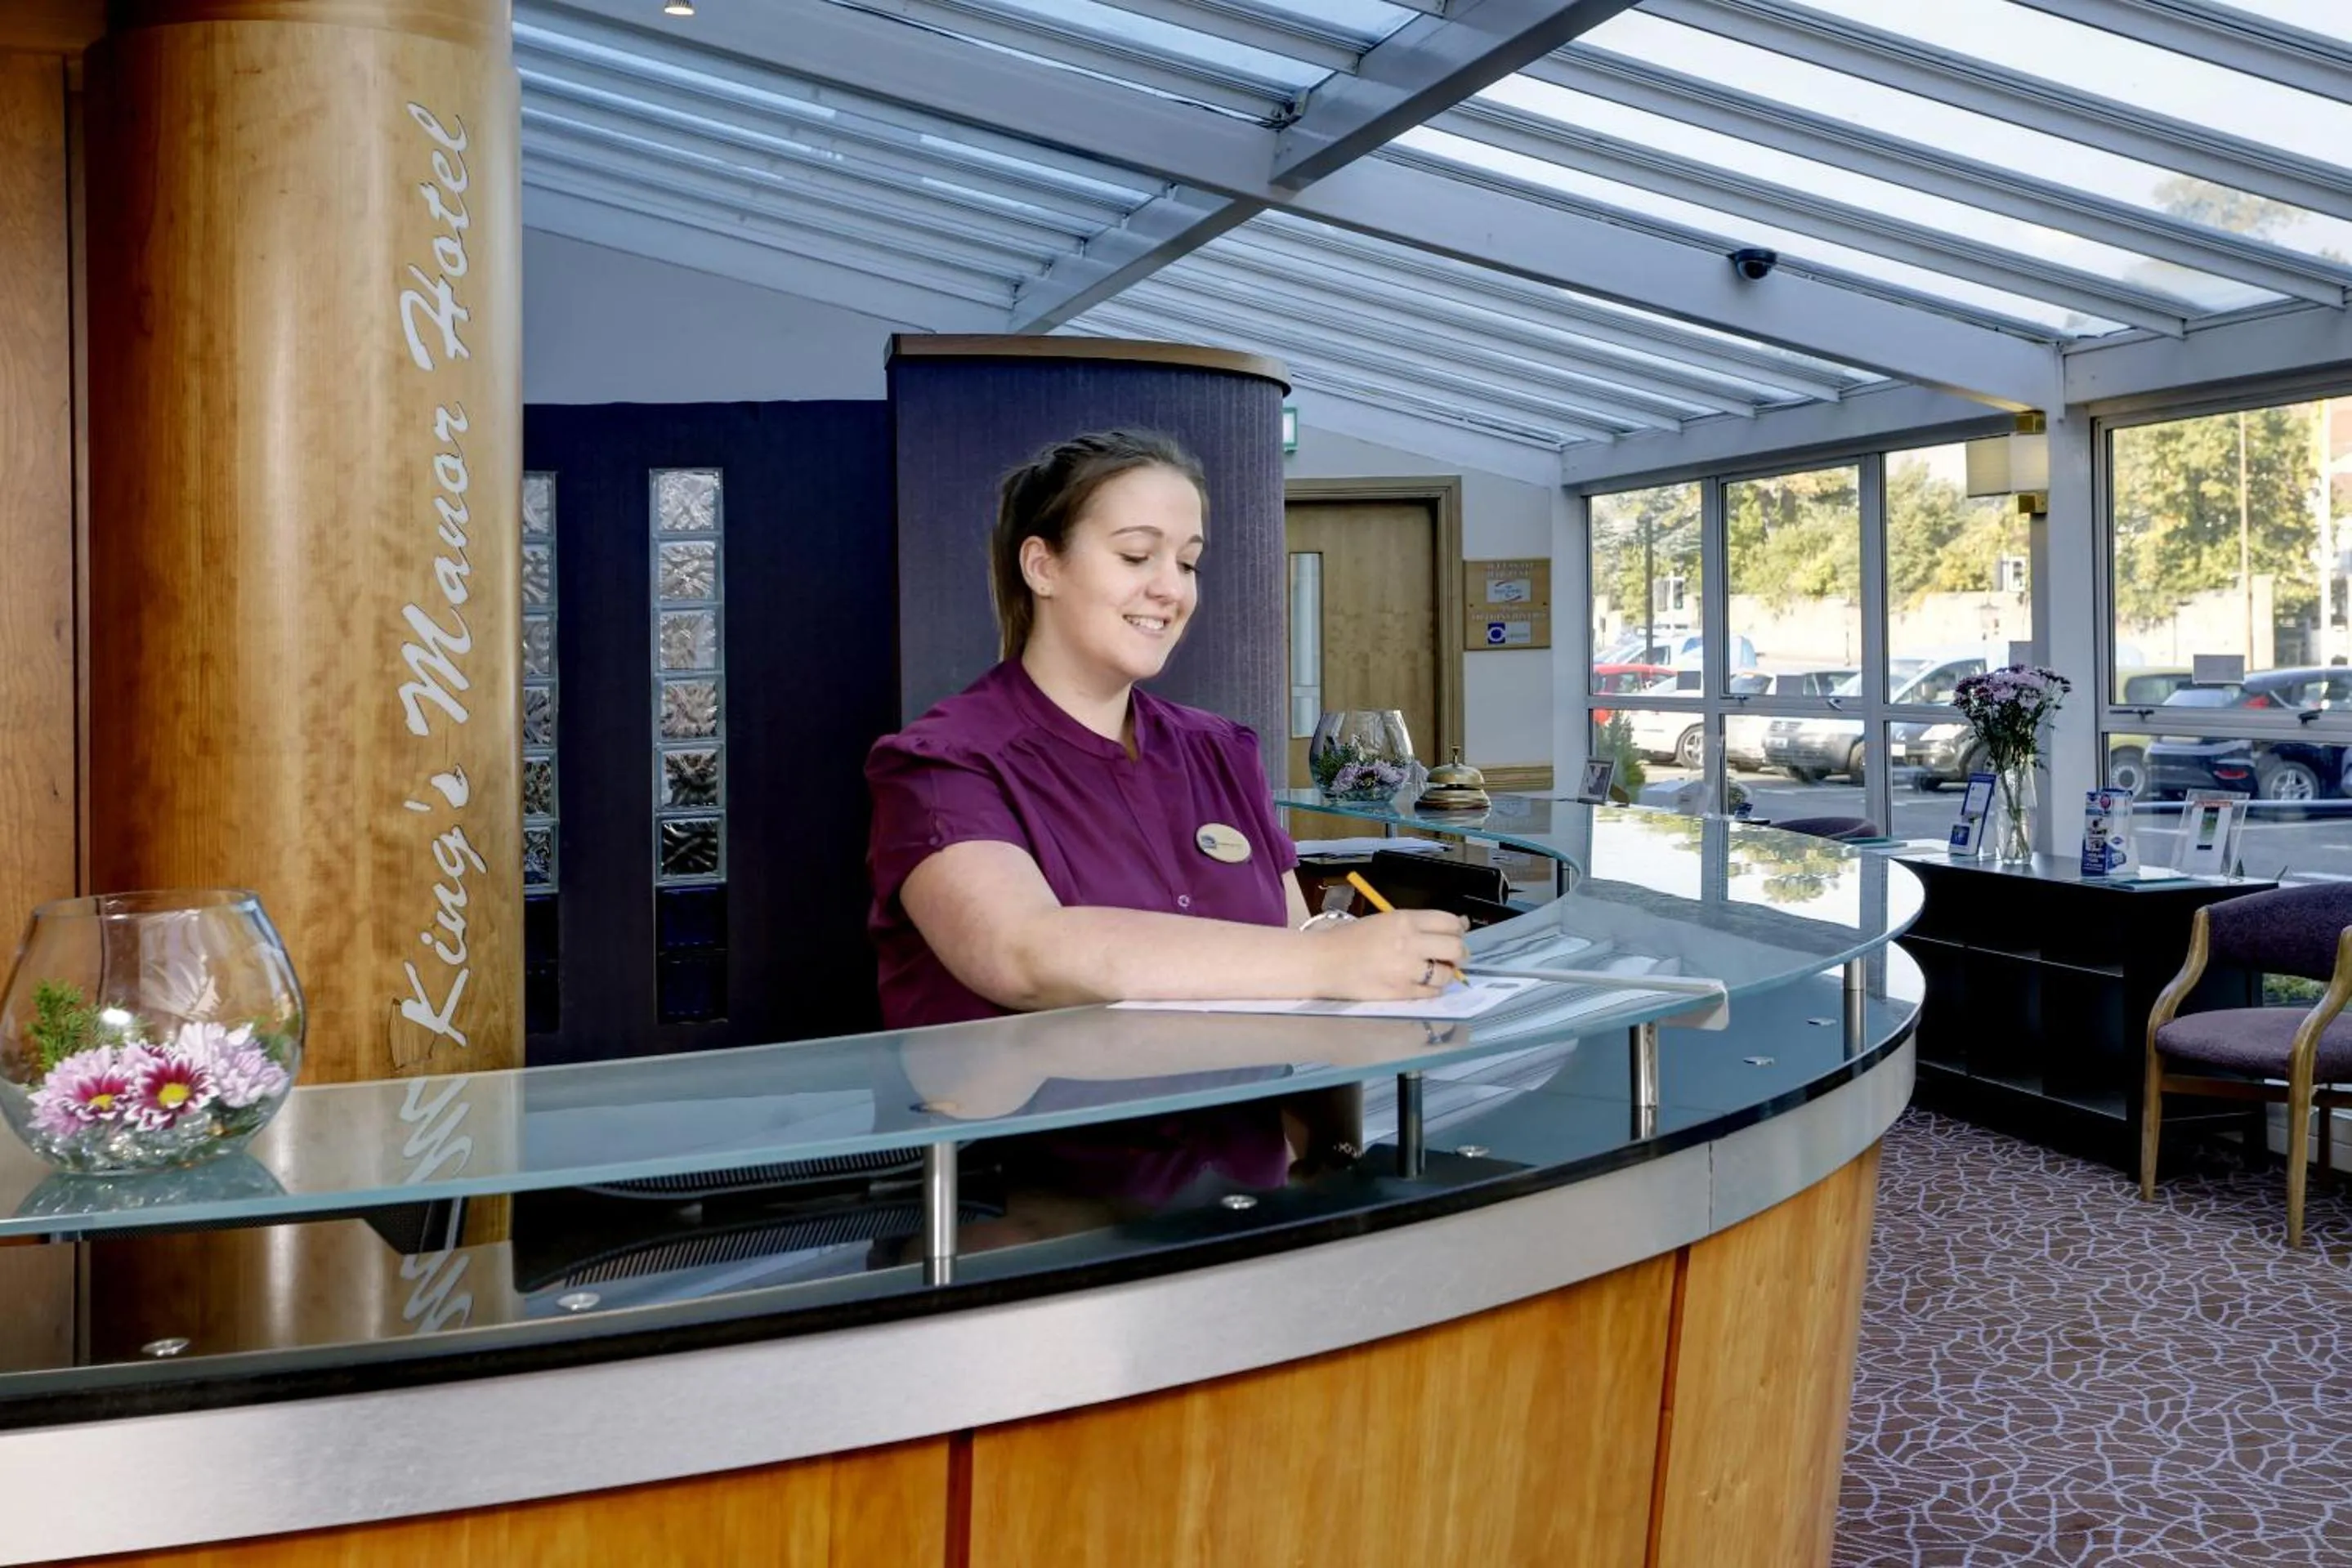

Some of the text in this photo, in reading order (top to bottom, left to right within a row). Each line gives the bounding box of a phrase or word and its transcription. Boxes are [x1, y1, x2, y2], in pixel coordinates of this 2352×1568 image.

[400, 101, 472, 371] Hotel
[399, 401, 472, 736] Manor
[400, 764, 488, 1046] King's
